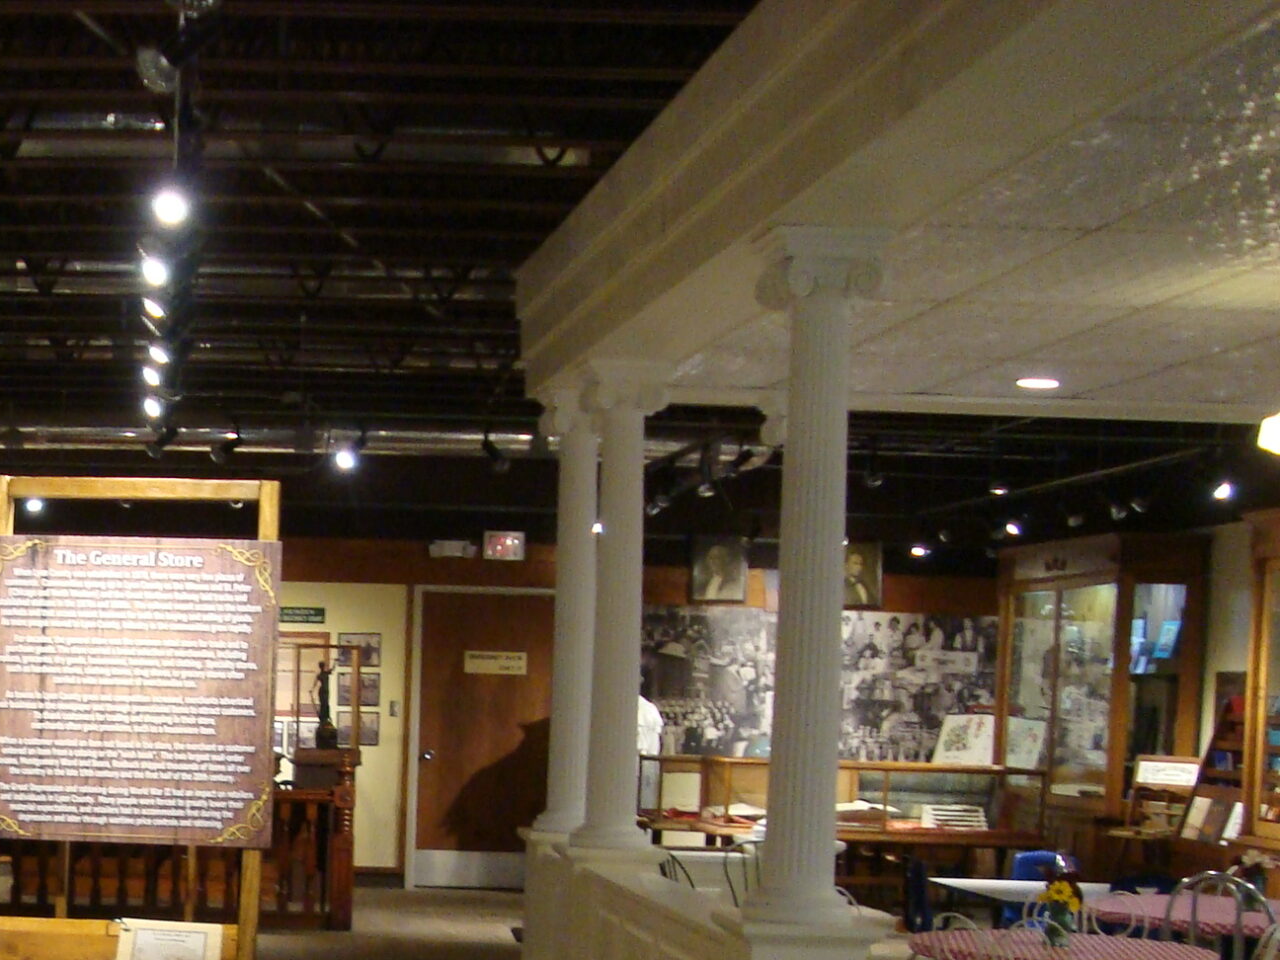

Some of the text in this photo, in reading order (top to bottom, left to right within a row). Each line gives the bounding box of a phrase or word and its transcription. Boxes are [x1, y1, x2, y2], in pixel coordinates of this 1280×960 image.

[53, 549, 205, 569] The General Store
